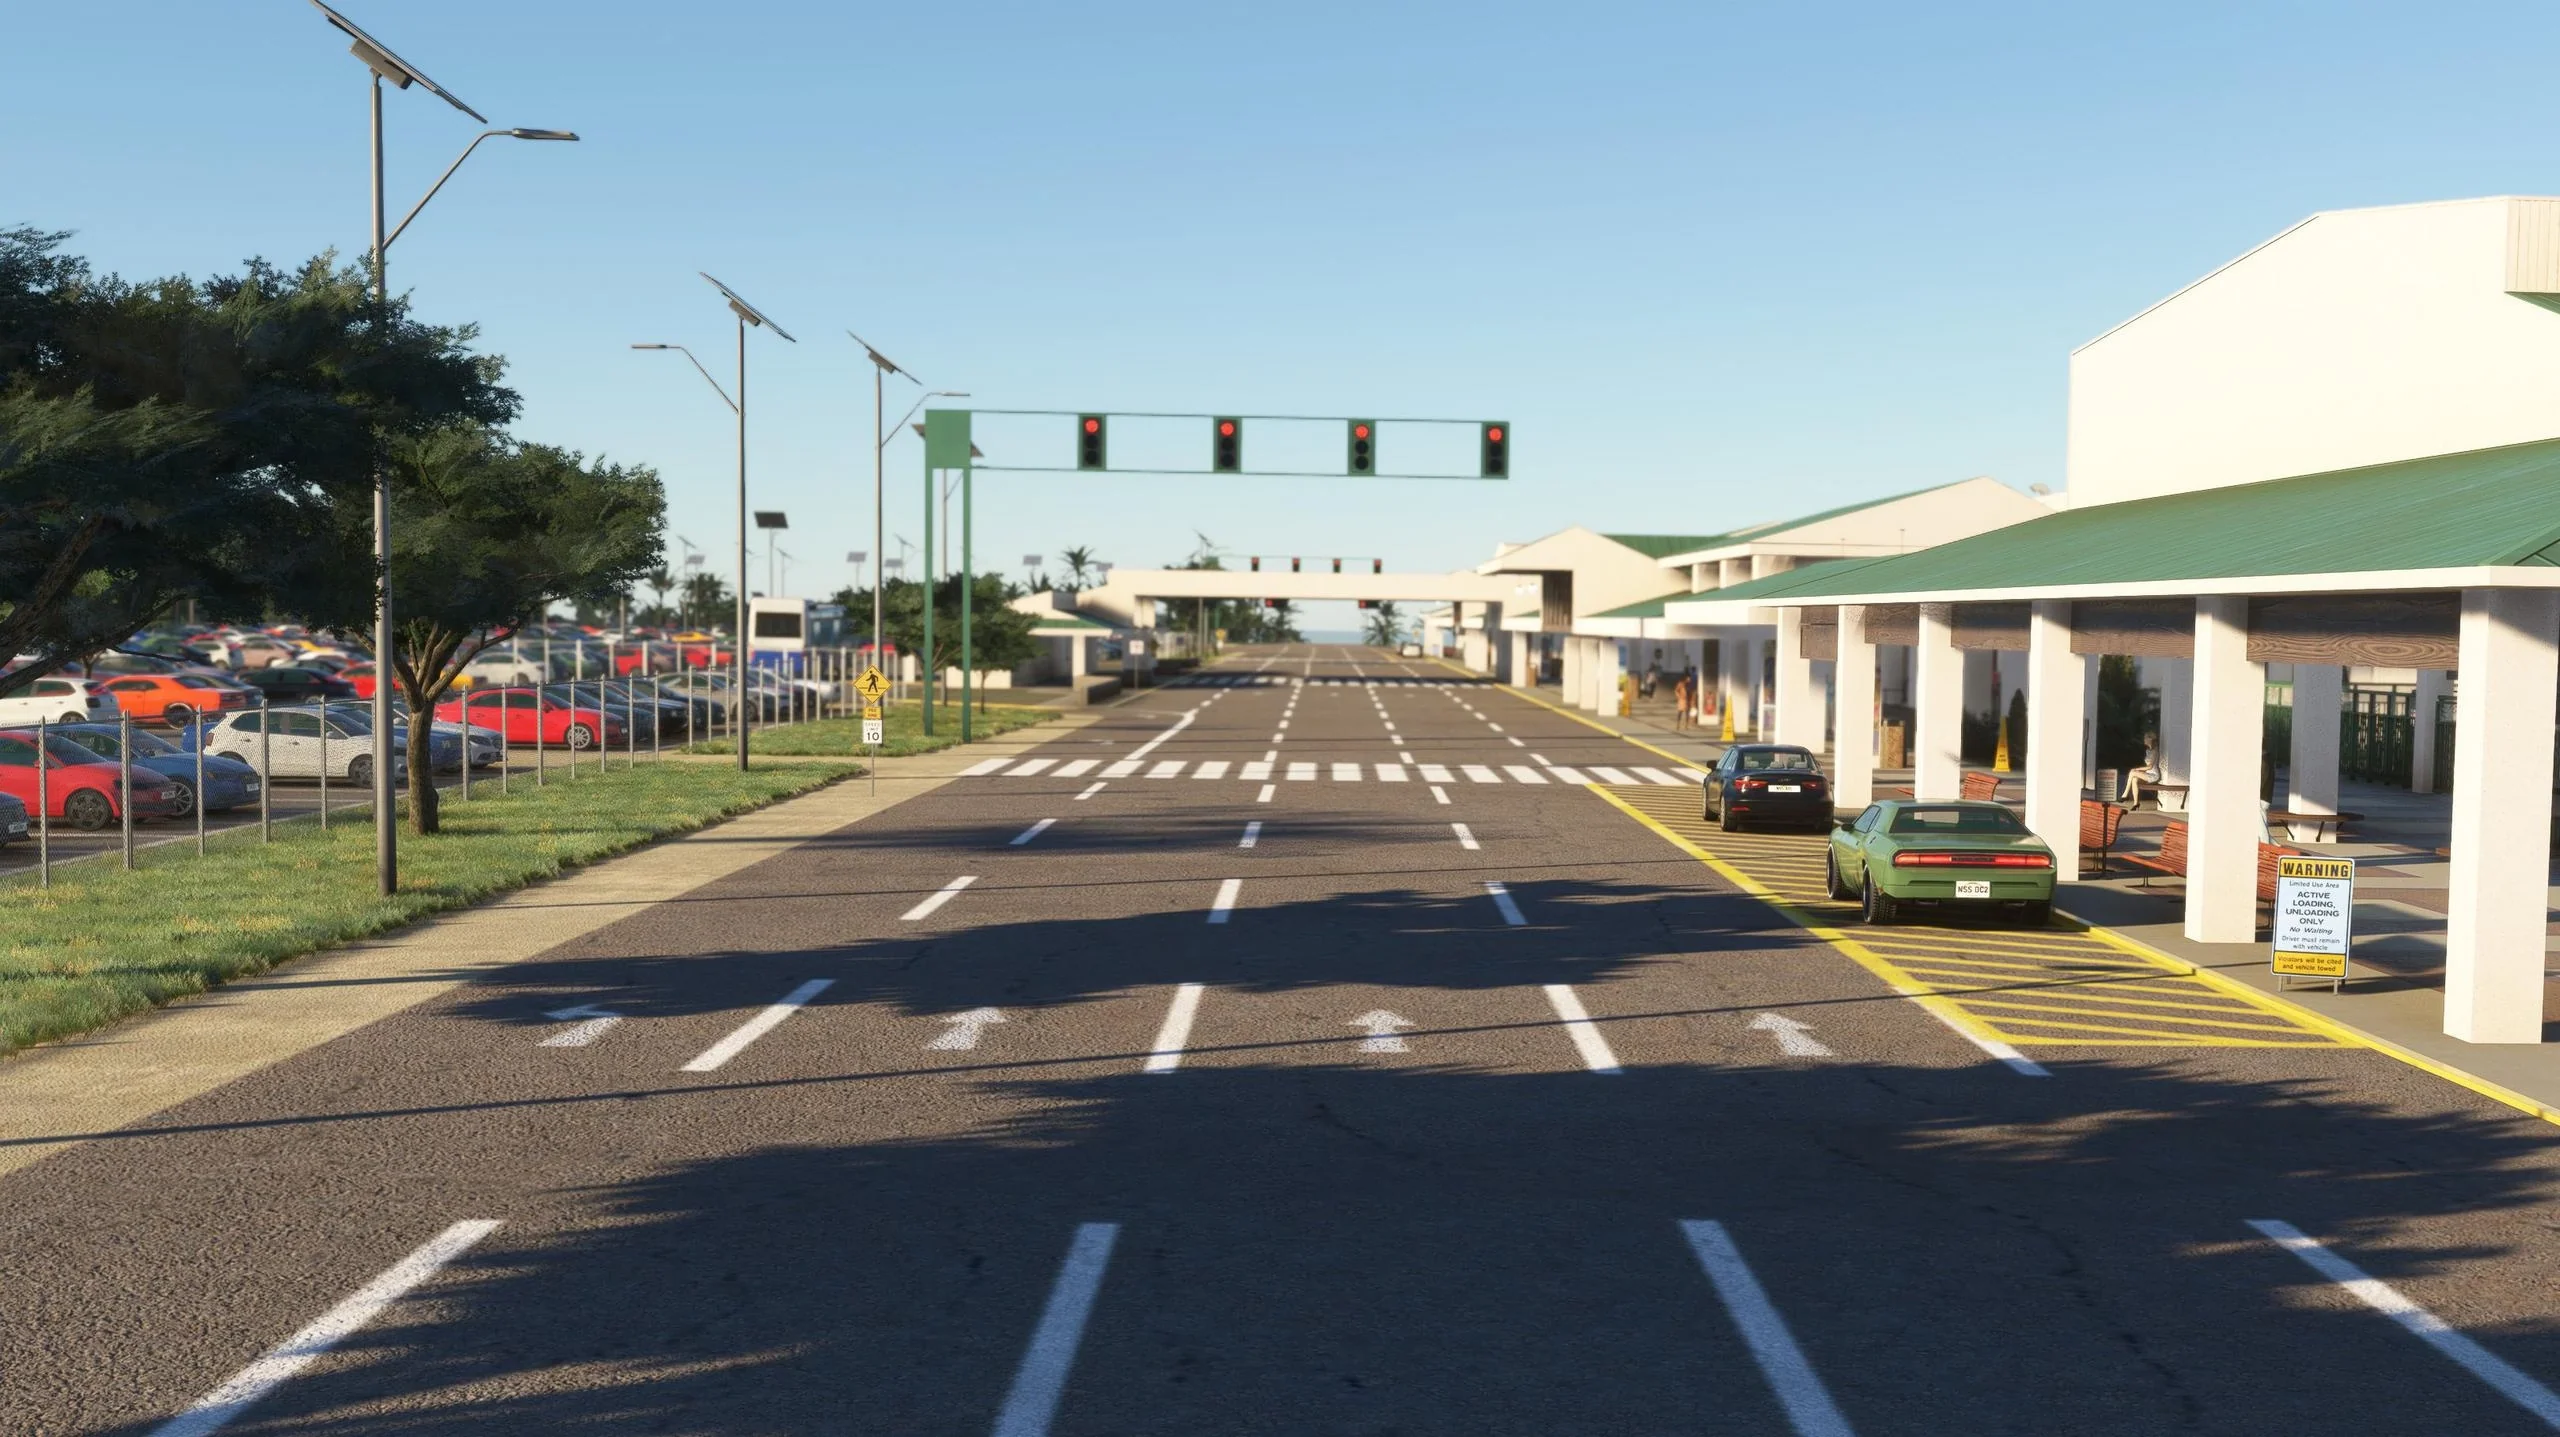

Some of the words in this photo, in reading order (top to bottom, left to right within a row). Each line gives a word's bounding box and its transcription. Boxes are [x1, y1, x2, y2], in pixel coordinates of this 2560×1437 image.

[867, 732, 880, 741] 10
[2284, 862, 2348, 877] WARNING
[2297, 891, 2331, 899] ACTIVE
[2293, 900, 2336, 909] LOADING,
[2286, 908, 2339, 917] UNLOADING
[2304, 927, 2333, 935] Waiting
